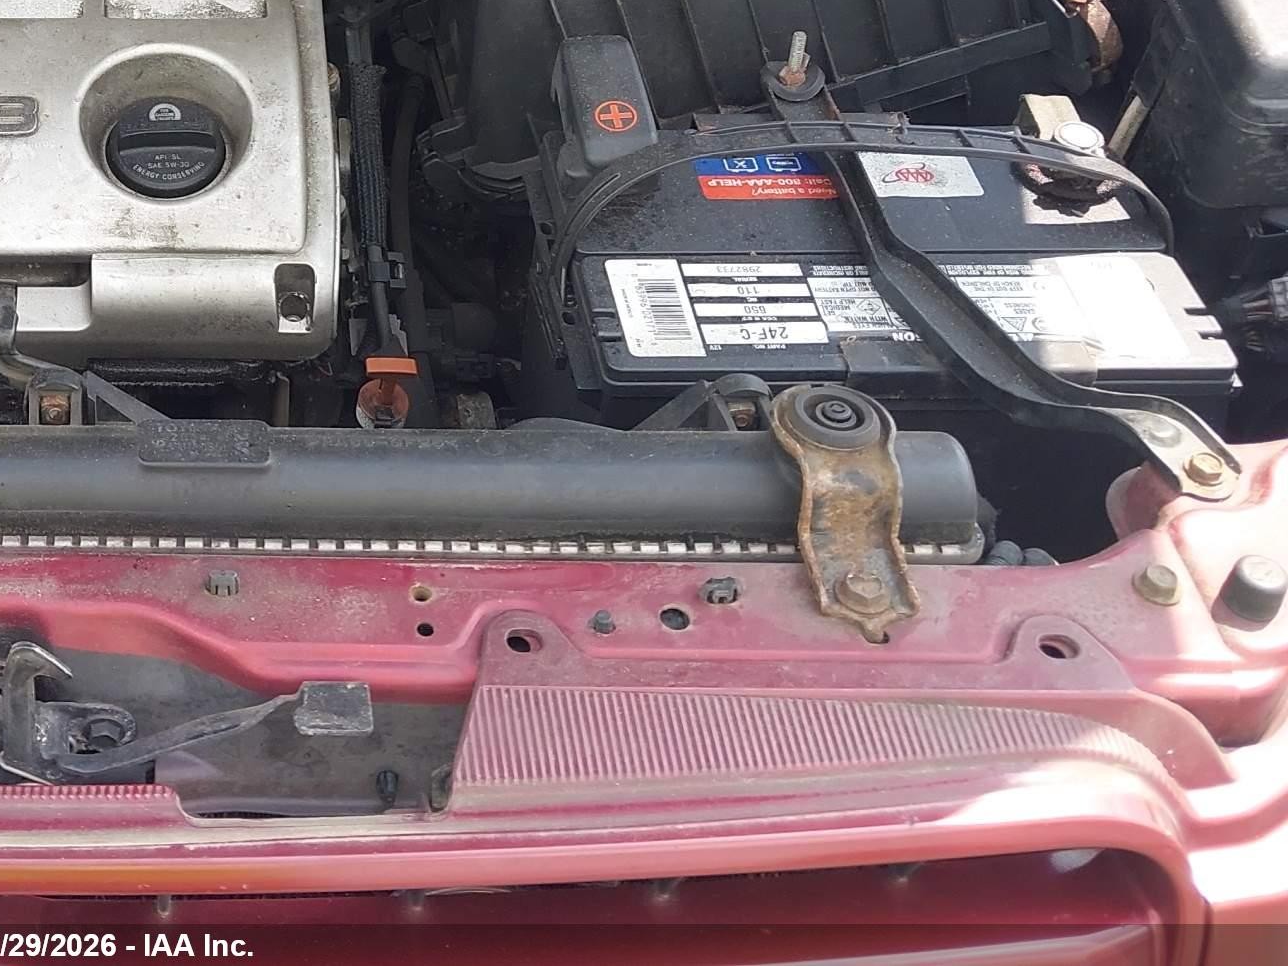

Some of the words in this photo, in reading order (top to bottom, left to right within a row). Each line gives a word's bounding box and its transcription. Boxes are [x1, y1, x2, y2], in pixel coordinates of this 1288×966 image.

[132, 164, 159, 178] ENERGY
[162, 162, 205, 180] CONSERVING
[707, 178, 801, 186] 800-AAA-HELP
[751, 187, 795, 196] battery?
[737, 286, 759, 294] 110
[740, 326, 788, 340] 24F-C
